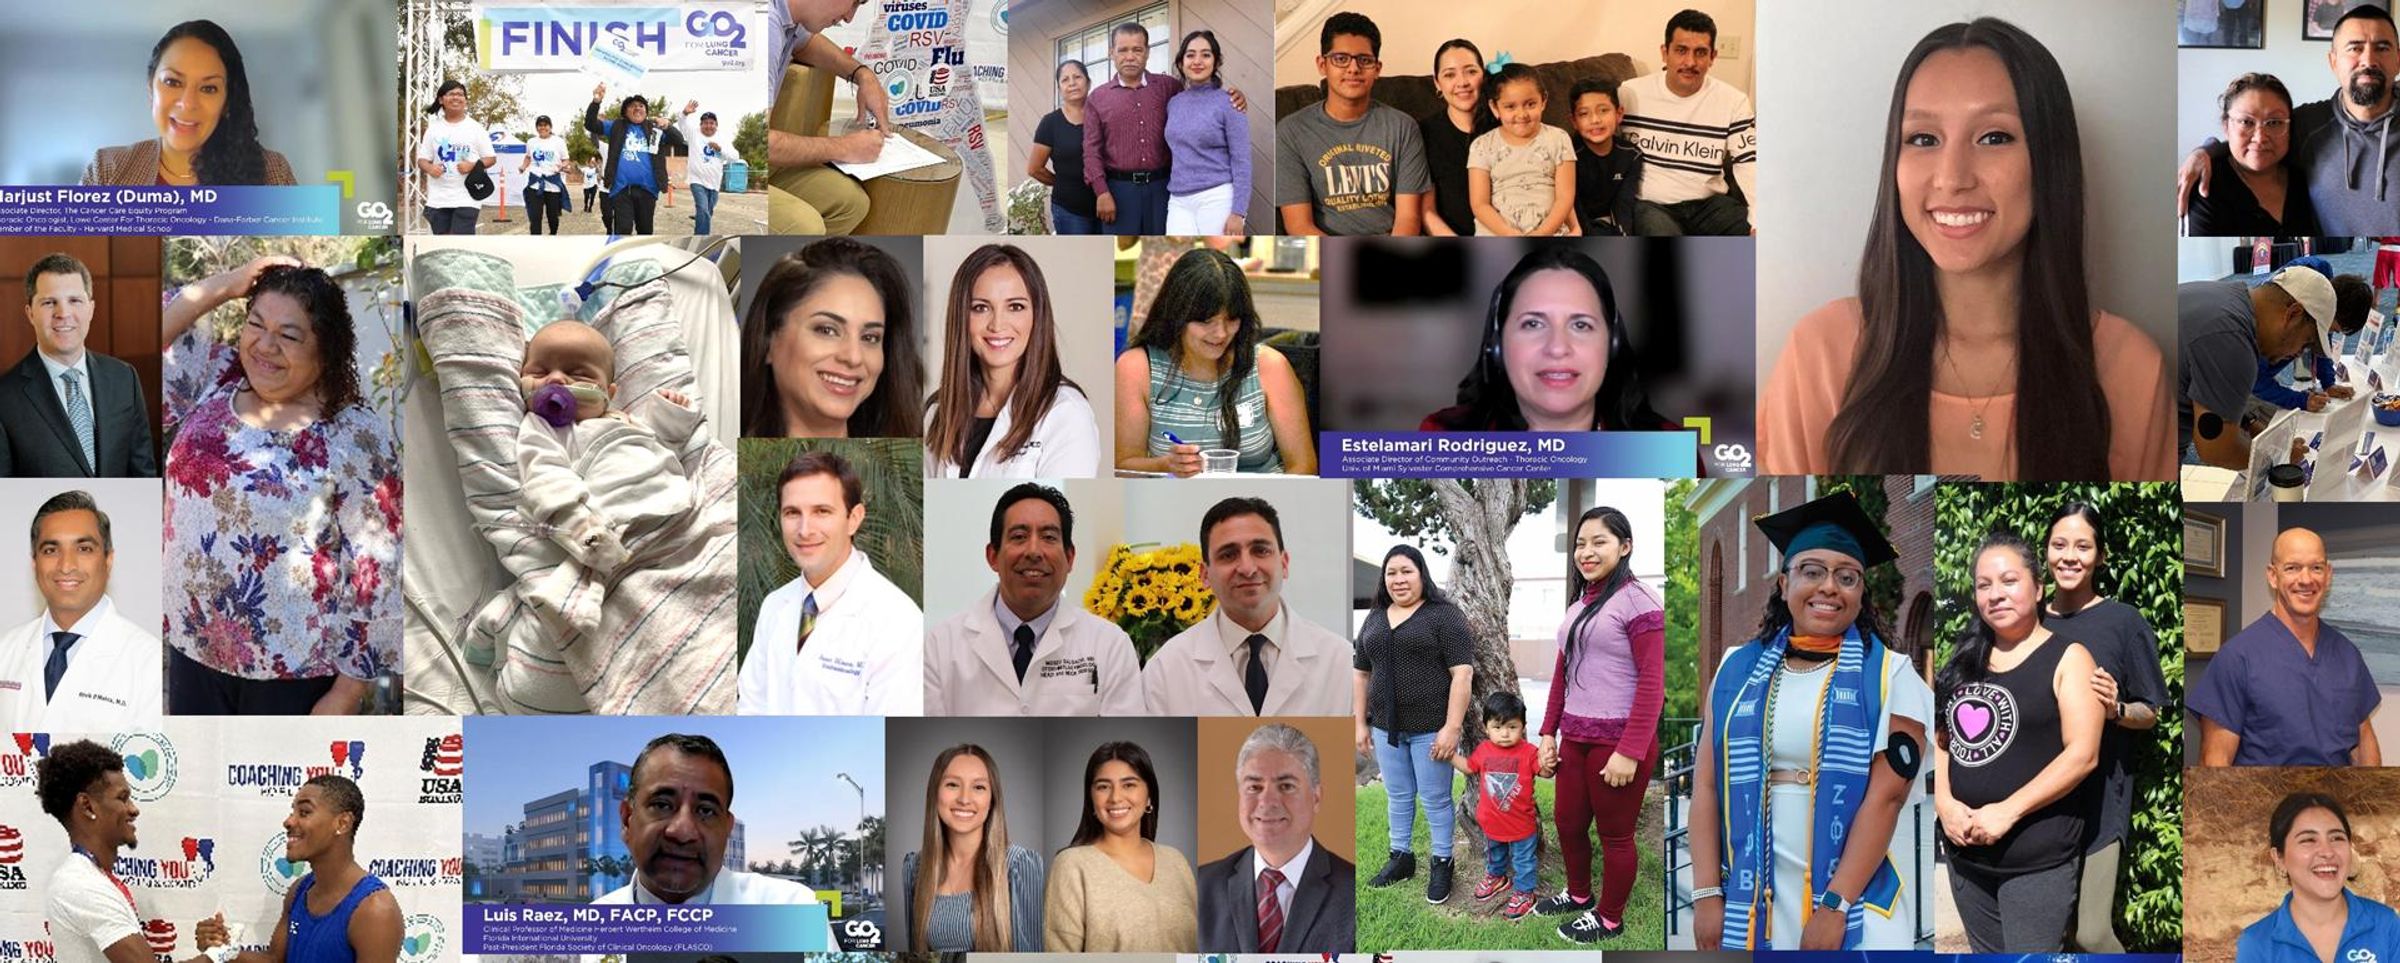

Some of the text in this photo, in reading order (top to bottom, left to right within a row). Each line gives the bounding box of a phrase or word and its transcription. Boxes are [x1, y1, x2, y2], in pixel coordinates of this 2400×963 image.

[883, 1, 927, 12] viruses
[686, 10, 746, 48] GO2
[887, 11, 948, 32] COVID
[910, 30, 944, 47] RSV
[705, 49, 738, 57] CANCER
[931, 45, 964, 66] Flu
[873, 58, 917, 75] COVID
[967, 123, 985, 150] RSV
[1629, 131, 1679, 155] Calvin
[1683, 141, 1727, 160] Klein
[1318, 143, 1392, 168] ORIGINAL RIVETED
[1324, 162, 1390, 196] LEVI'S
[1324, 194, 1360, 206] QUALITY
[1964, 686, 1999, 701] LOVE
[1997, 696, 2013, 732] WITH
[1950, 737, 1973, 761] YOUR
[1979, 736, 2003, 758] ALL
[228, 764, 302, 787] COACHING
[421, 778, 463, 794] USA
[160, 860, 189, 879] YOU
[369, 858, 437, 877] COACHING
[24, 940, 54, 958] YOU
